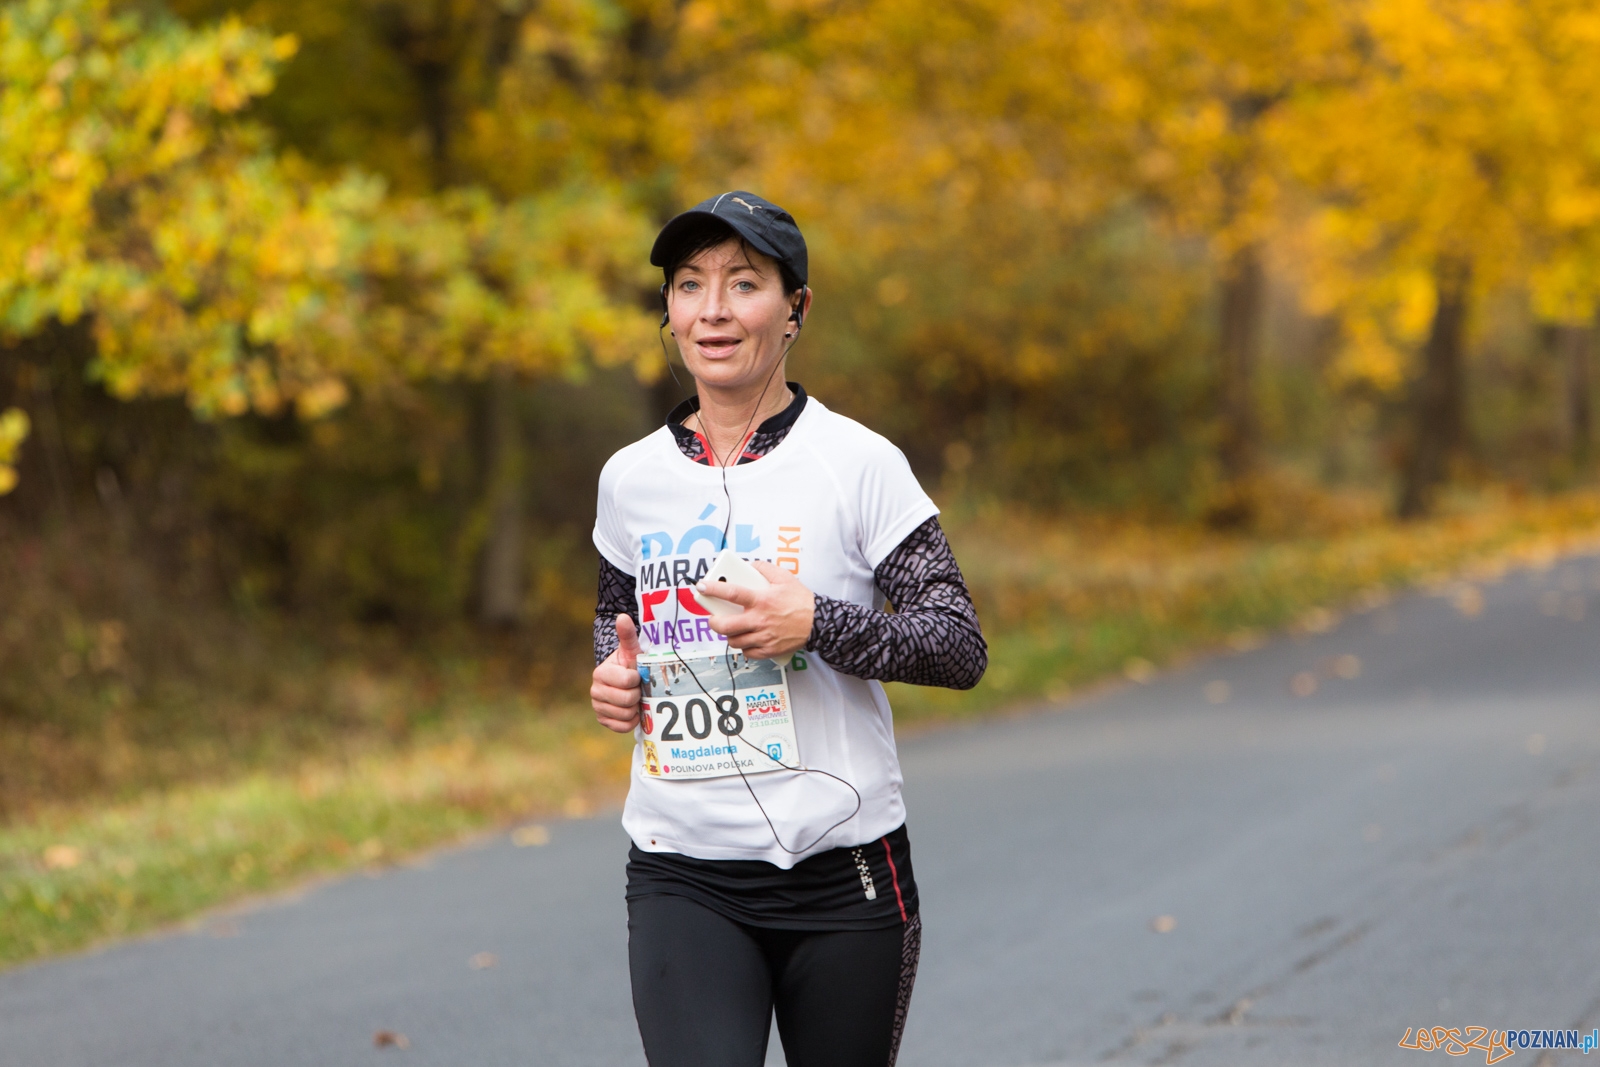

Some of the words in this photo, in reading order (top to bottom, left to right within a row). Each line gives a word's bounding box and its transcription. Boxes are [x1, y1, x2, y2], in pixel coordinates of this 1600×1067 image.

[746, 699, 780, 709] MARATON
[656, 694, 744, 742] 208
[749, 717, 789, 728] 23.10.2016
[671, 745, 738, 761] Magdalena
[671, 763, 715, 773] POLINOVA
[717, 759, 754, 770] POLSKA
